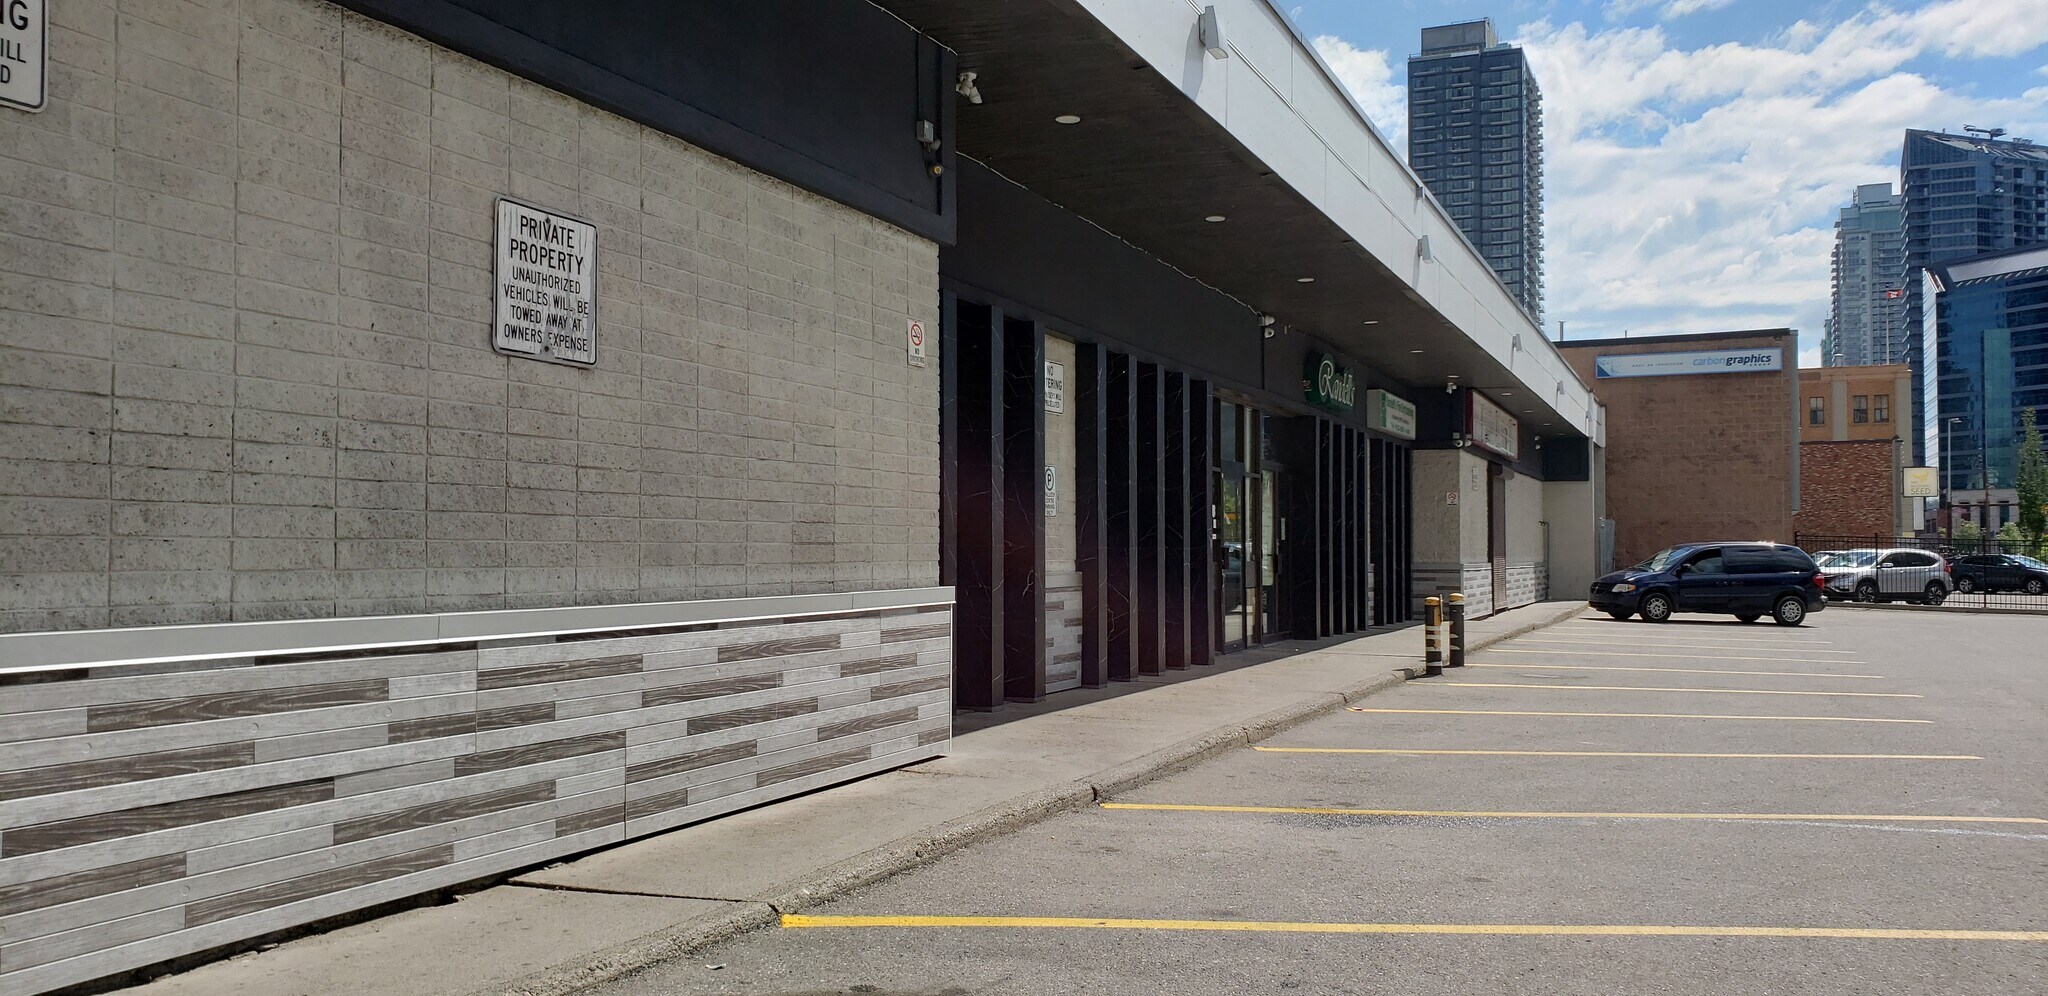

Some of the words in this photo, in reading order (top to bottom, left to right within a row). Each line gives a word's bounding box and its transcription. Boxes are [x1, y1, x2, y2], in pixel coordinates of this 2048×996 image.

[520, 214, 575, 249] PRIVATE
[510, 238, 583, 275] PROPERTY
[512, 266, 581, 294] UNAUTHORIZED
[503, 283, 549, 306] VEHICLES
[552, 294, 574, 313] WILL
[577, 300, 589, 315] BE
[511, 305, 542, 324] TOWED
[546, 312, 568, 330] AWAY
[571, 318, 582, 333] AT
[504, 323, 543, 344] OWNERS
[547, 332, 588, 352] EXPENSE
[1693, 354, 1772, 367] carbongraphics
[1910, 487, 1931, 495] SEED
